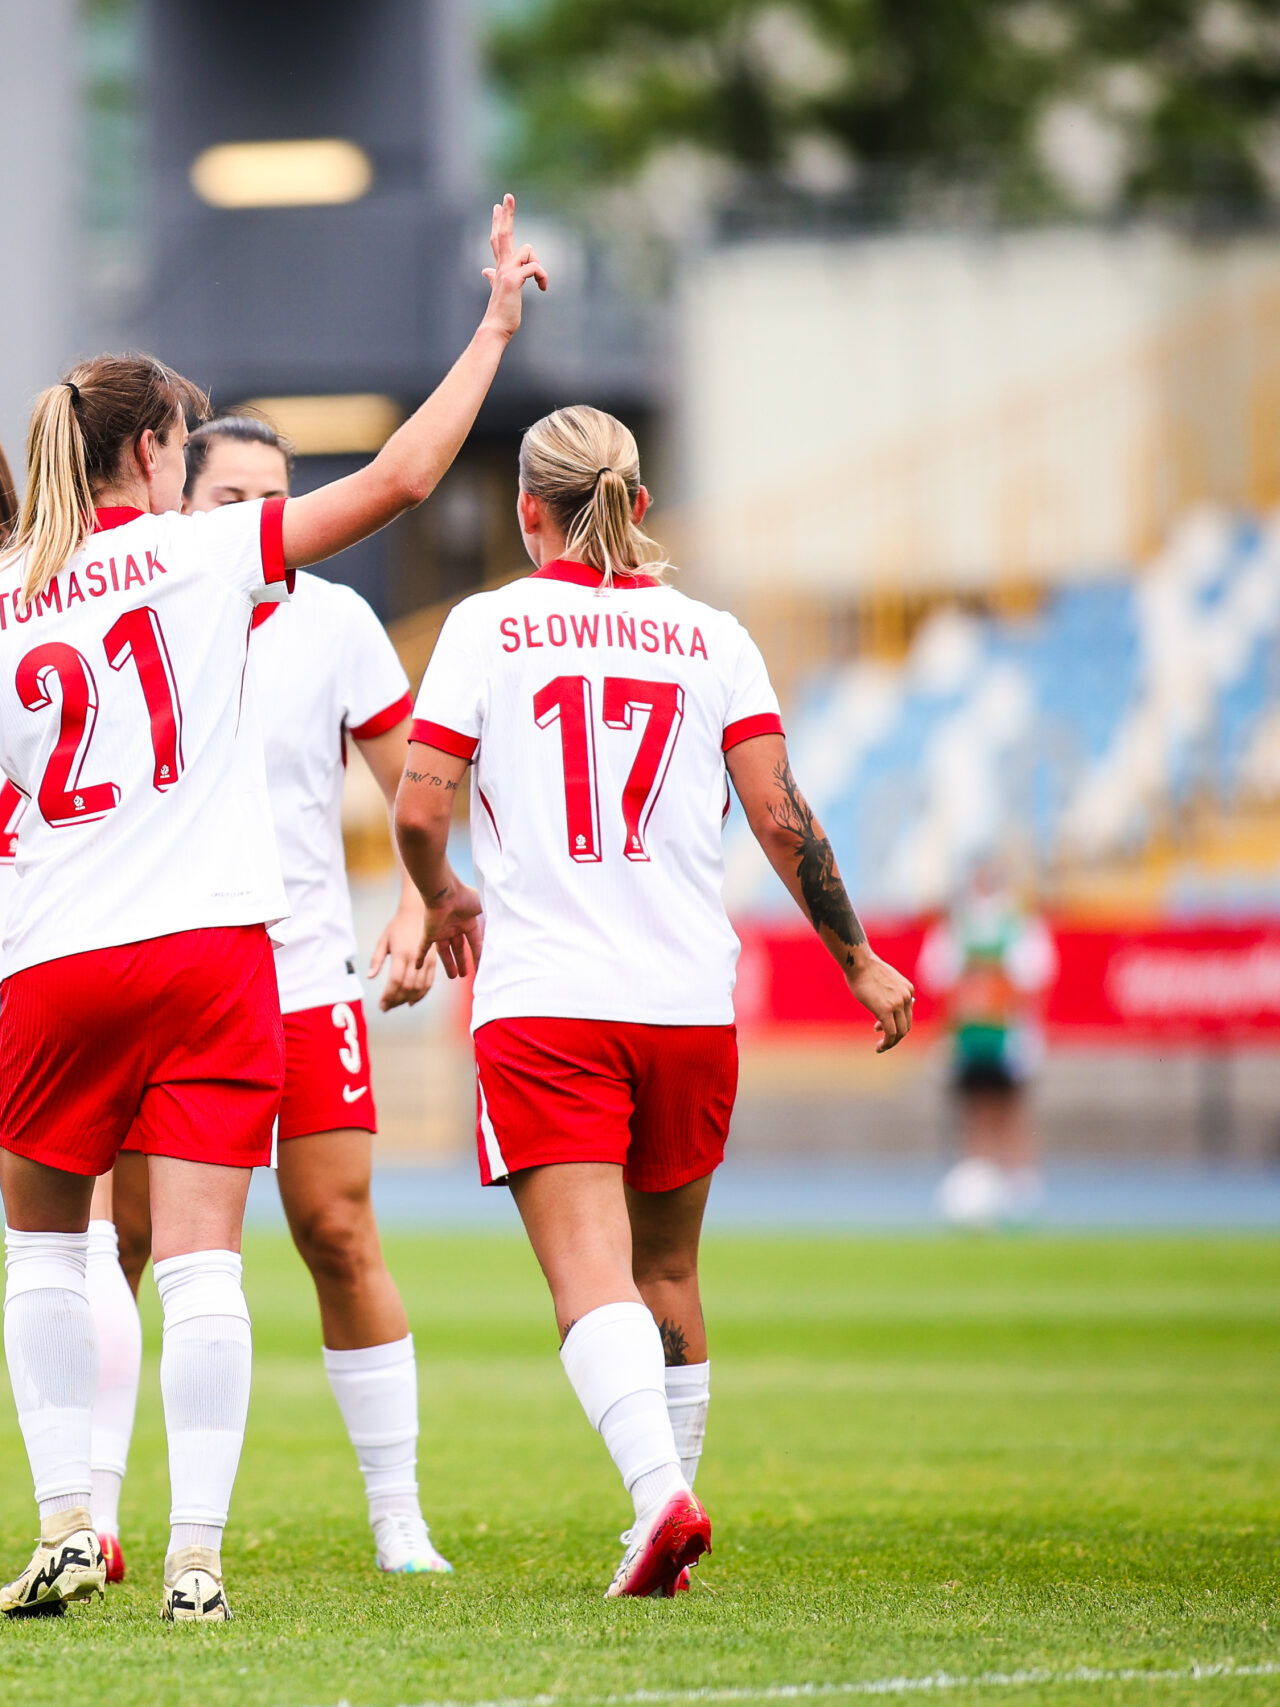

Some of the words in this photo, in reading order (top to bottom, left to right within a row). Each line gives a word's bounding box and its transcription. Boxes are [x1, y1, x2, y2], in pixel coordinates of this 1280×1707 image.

[500, 611, 708, 660] SŁOWIŃSKA
[15, 605, 184, 828] 21
[533, 675, 685, 863] 17
[331, 1002, 362, 1074] 3
